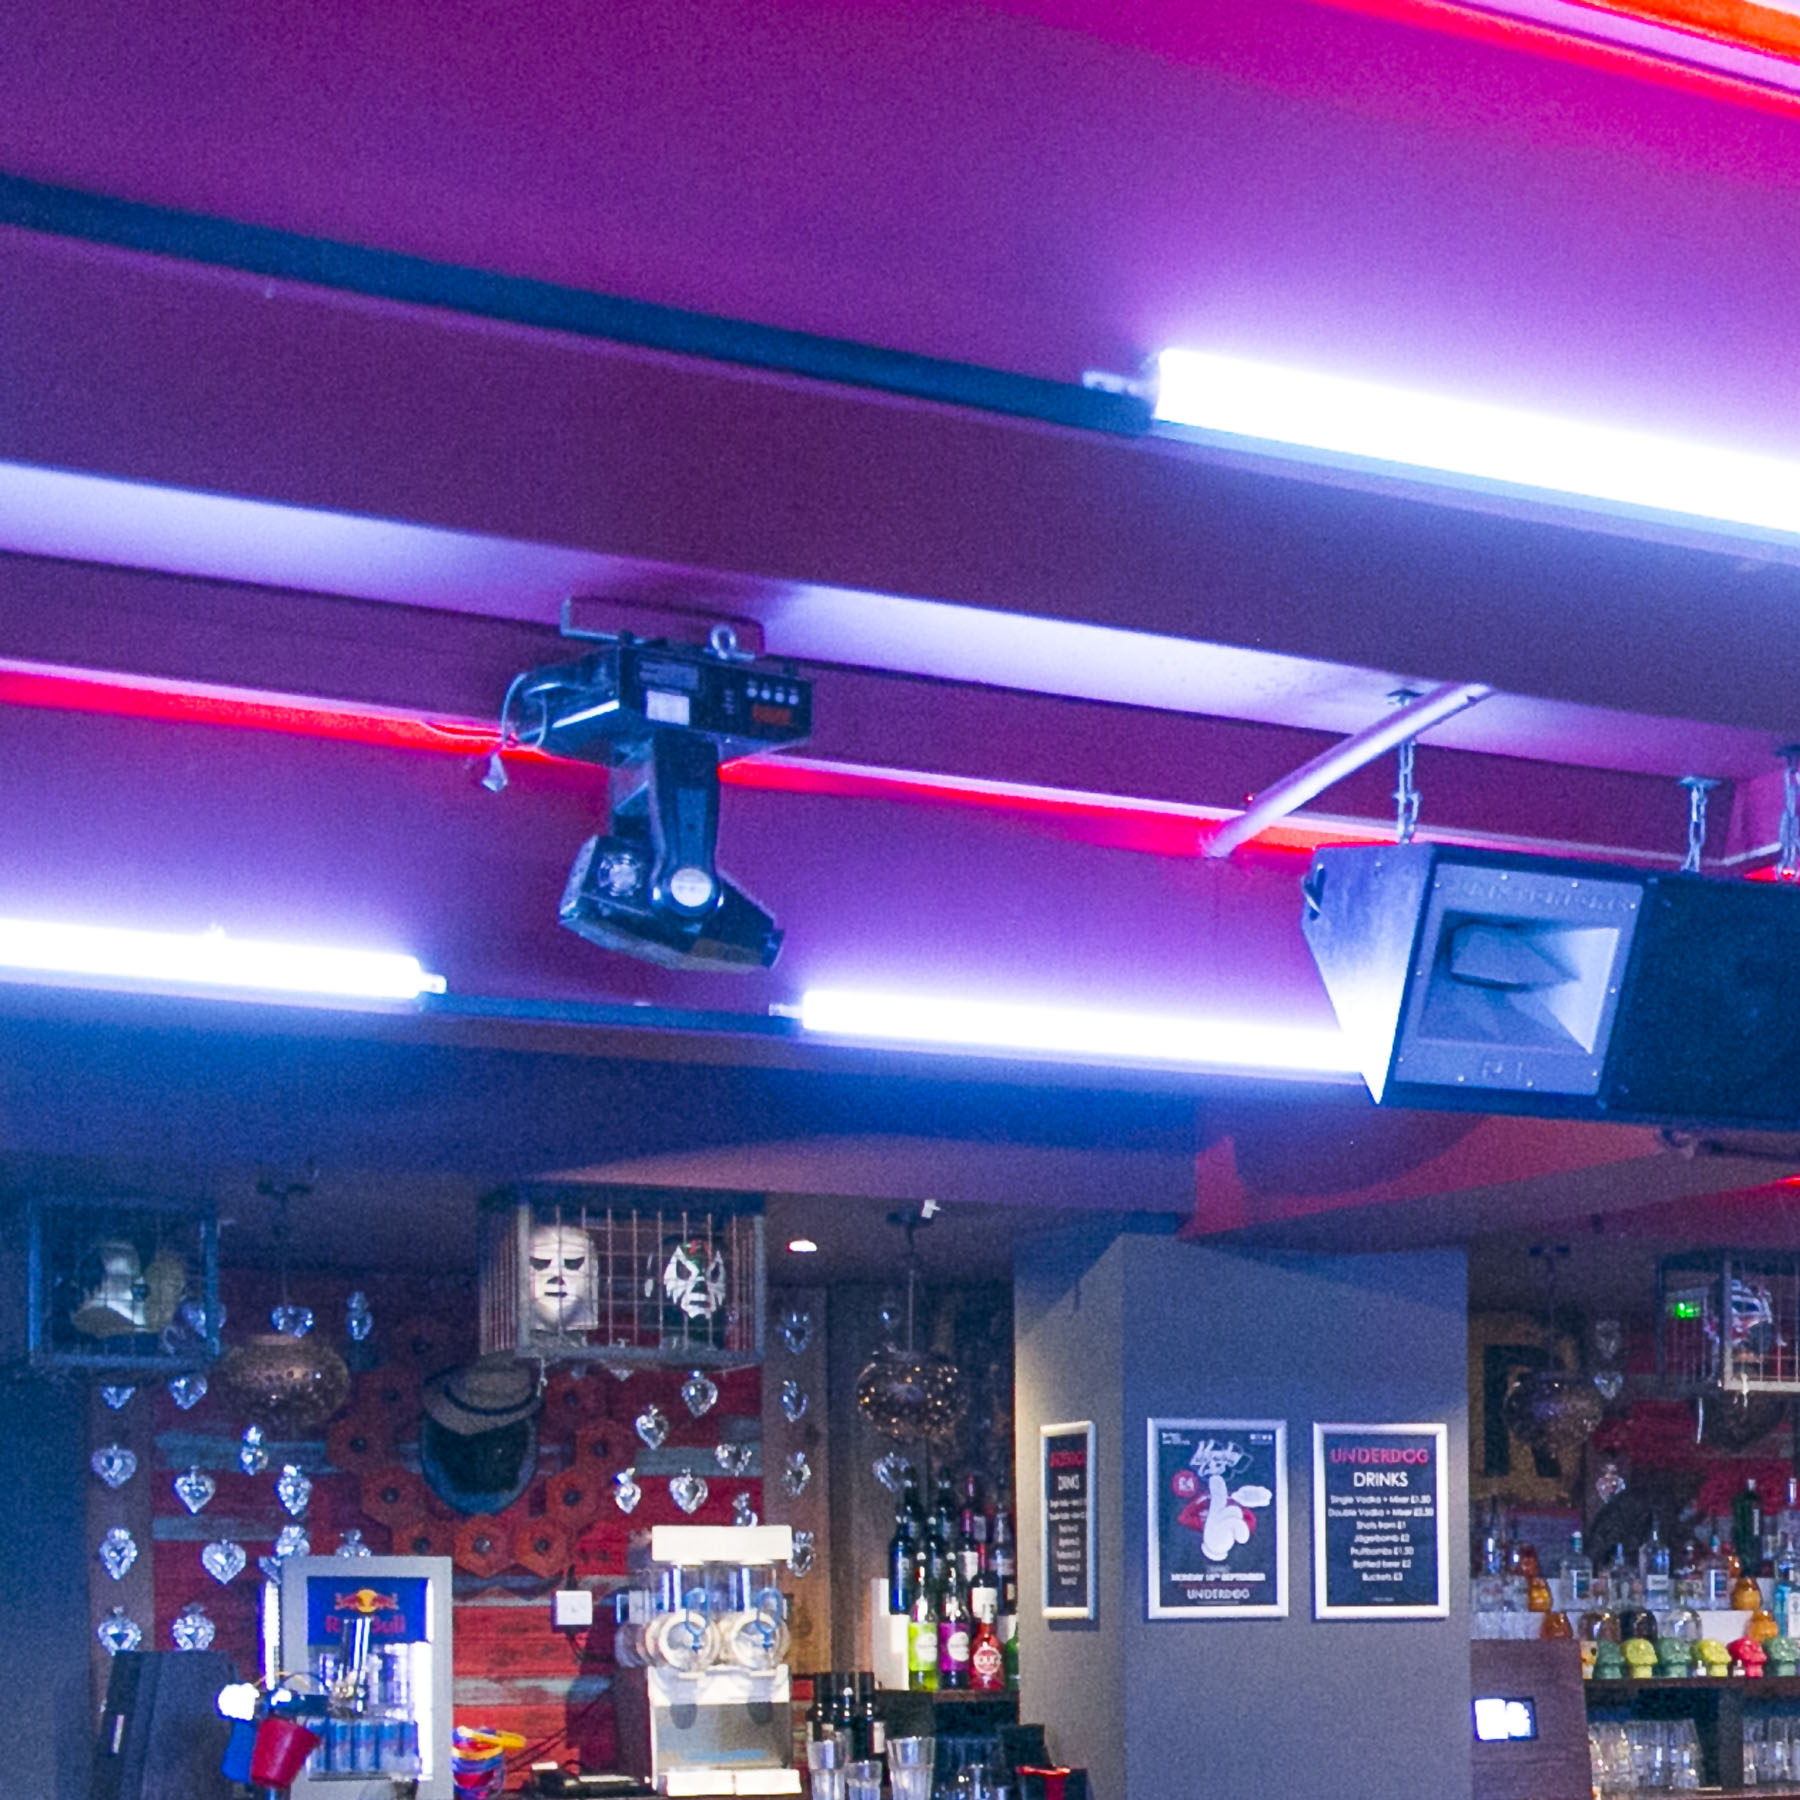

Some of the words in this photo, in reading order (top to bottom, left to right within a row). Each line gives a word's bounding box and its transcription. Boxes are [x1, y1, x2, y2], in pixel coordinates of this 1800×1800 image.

[1330, 1448, 1429, 1464] UNDERDOG
[1353, 1472, 1409, 1487] DRINKS
[1187, 1588, 1250, 1600] UNDERDOG
